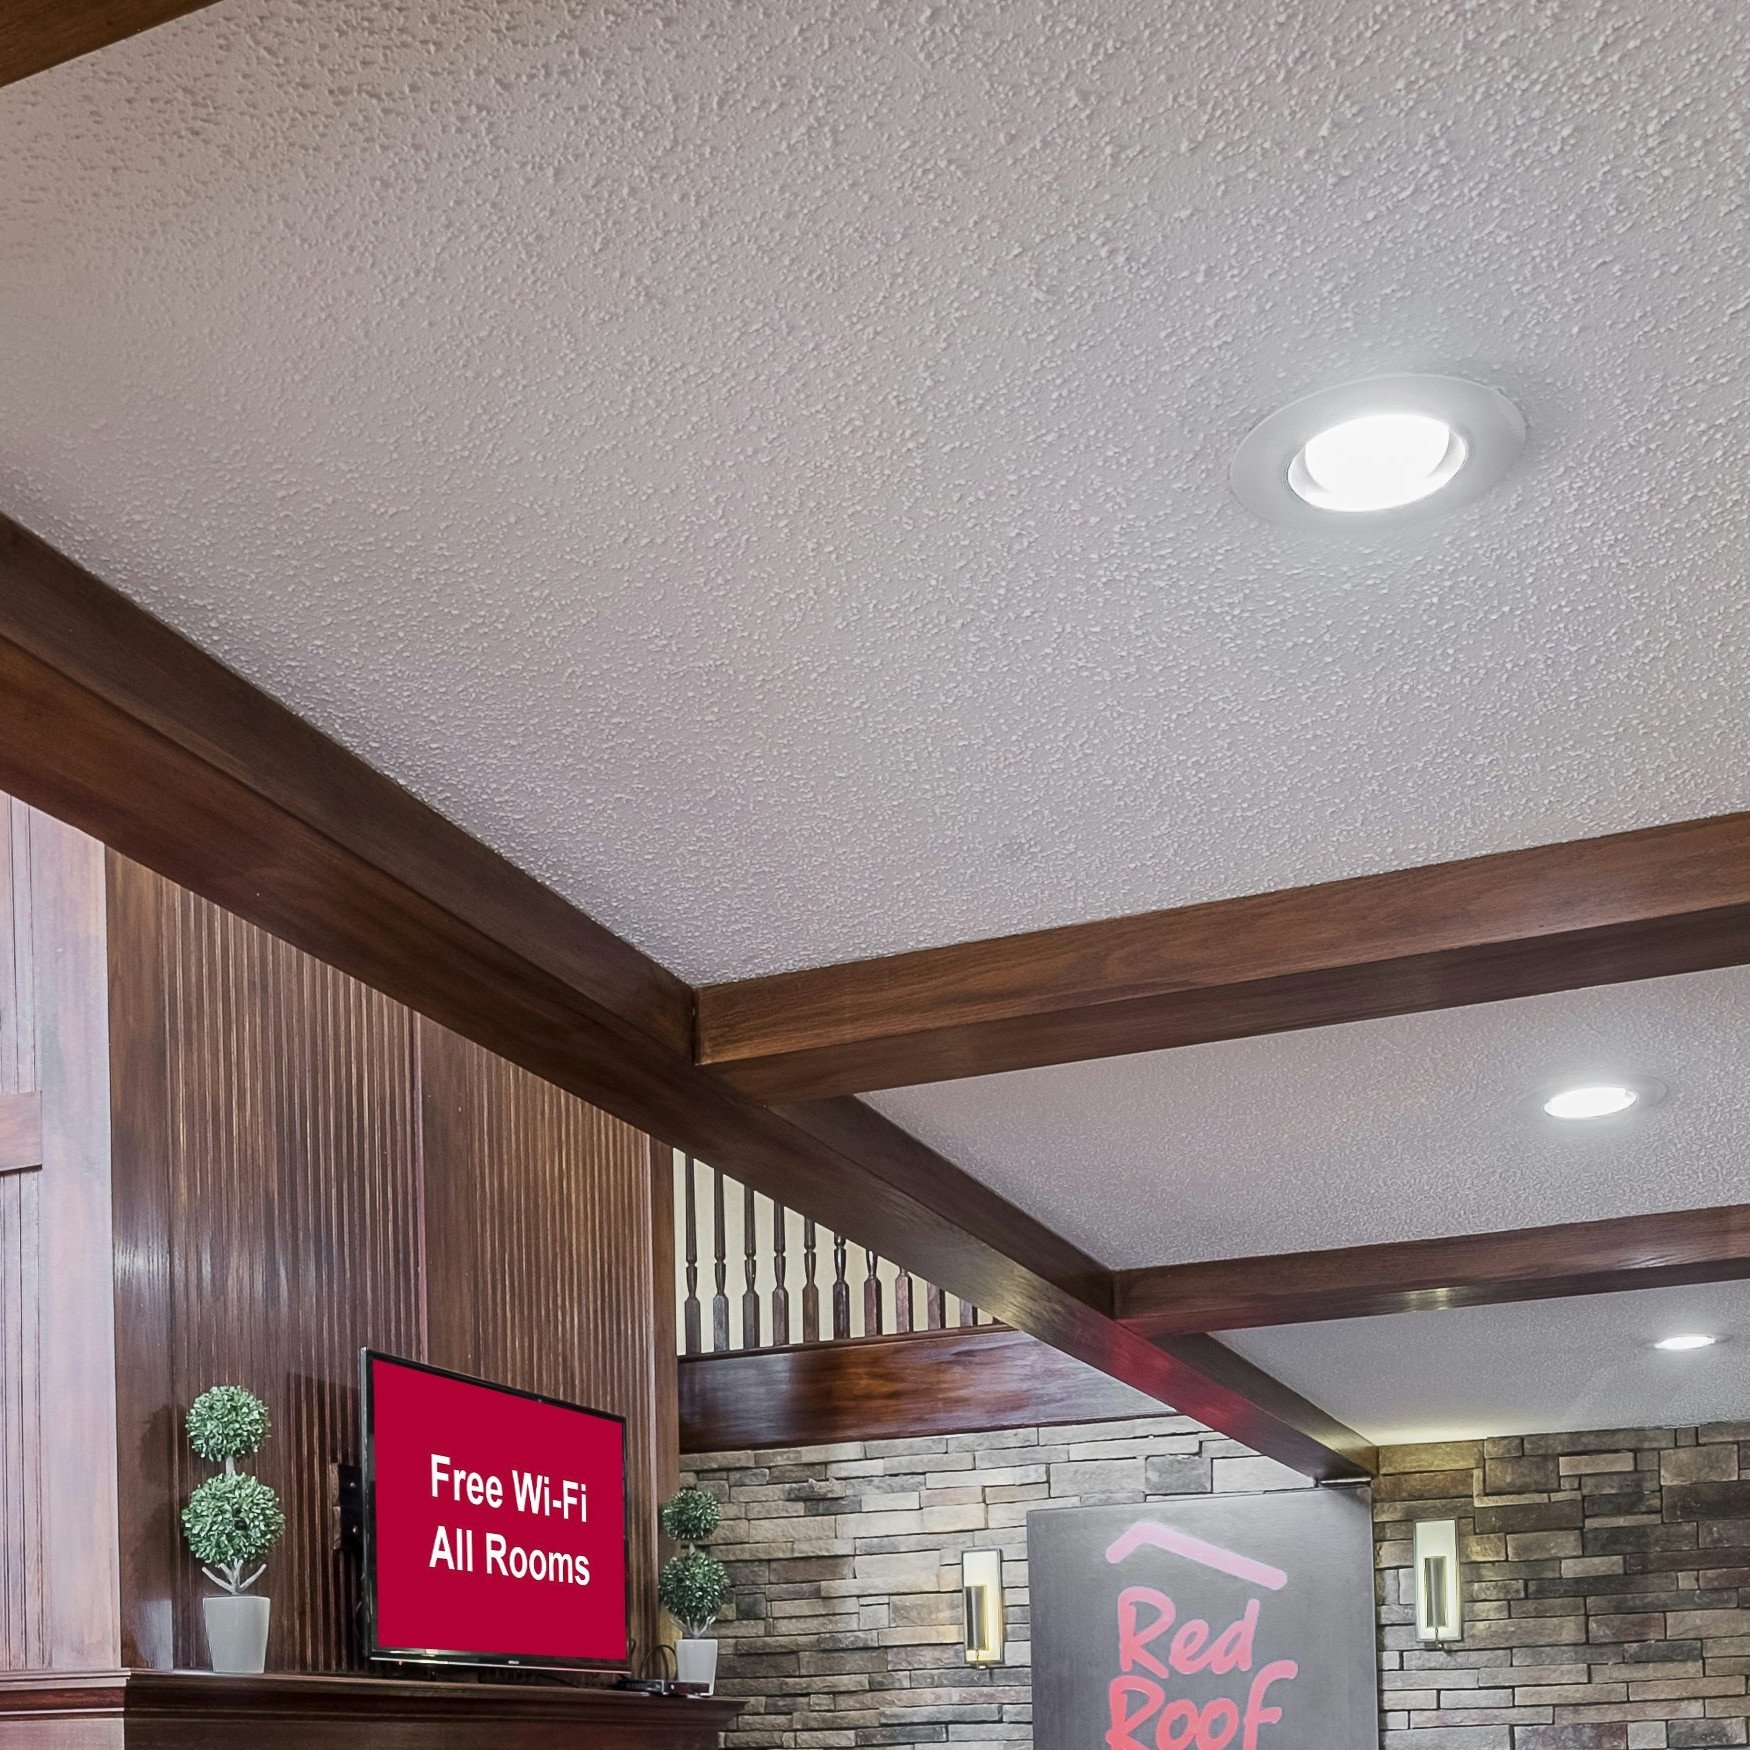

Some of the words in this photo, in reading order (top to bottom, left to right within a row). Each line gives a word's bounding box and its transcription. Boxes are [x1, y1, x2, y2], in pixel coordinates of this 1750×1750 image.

[430, 1453, 503, 1509] Free
[511, 1469, 587, 1522] Wi-Fi
[428, 1525, 474, 1573] All
[485, 1532, 590, 1586] Rooms
[1116, 1585, 1260, 1679] Red
